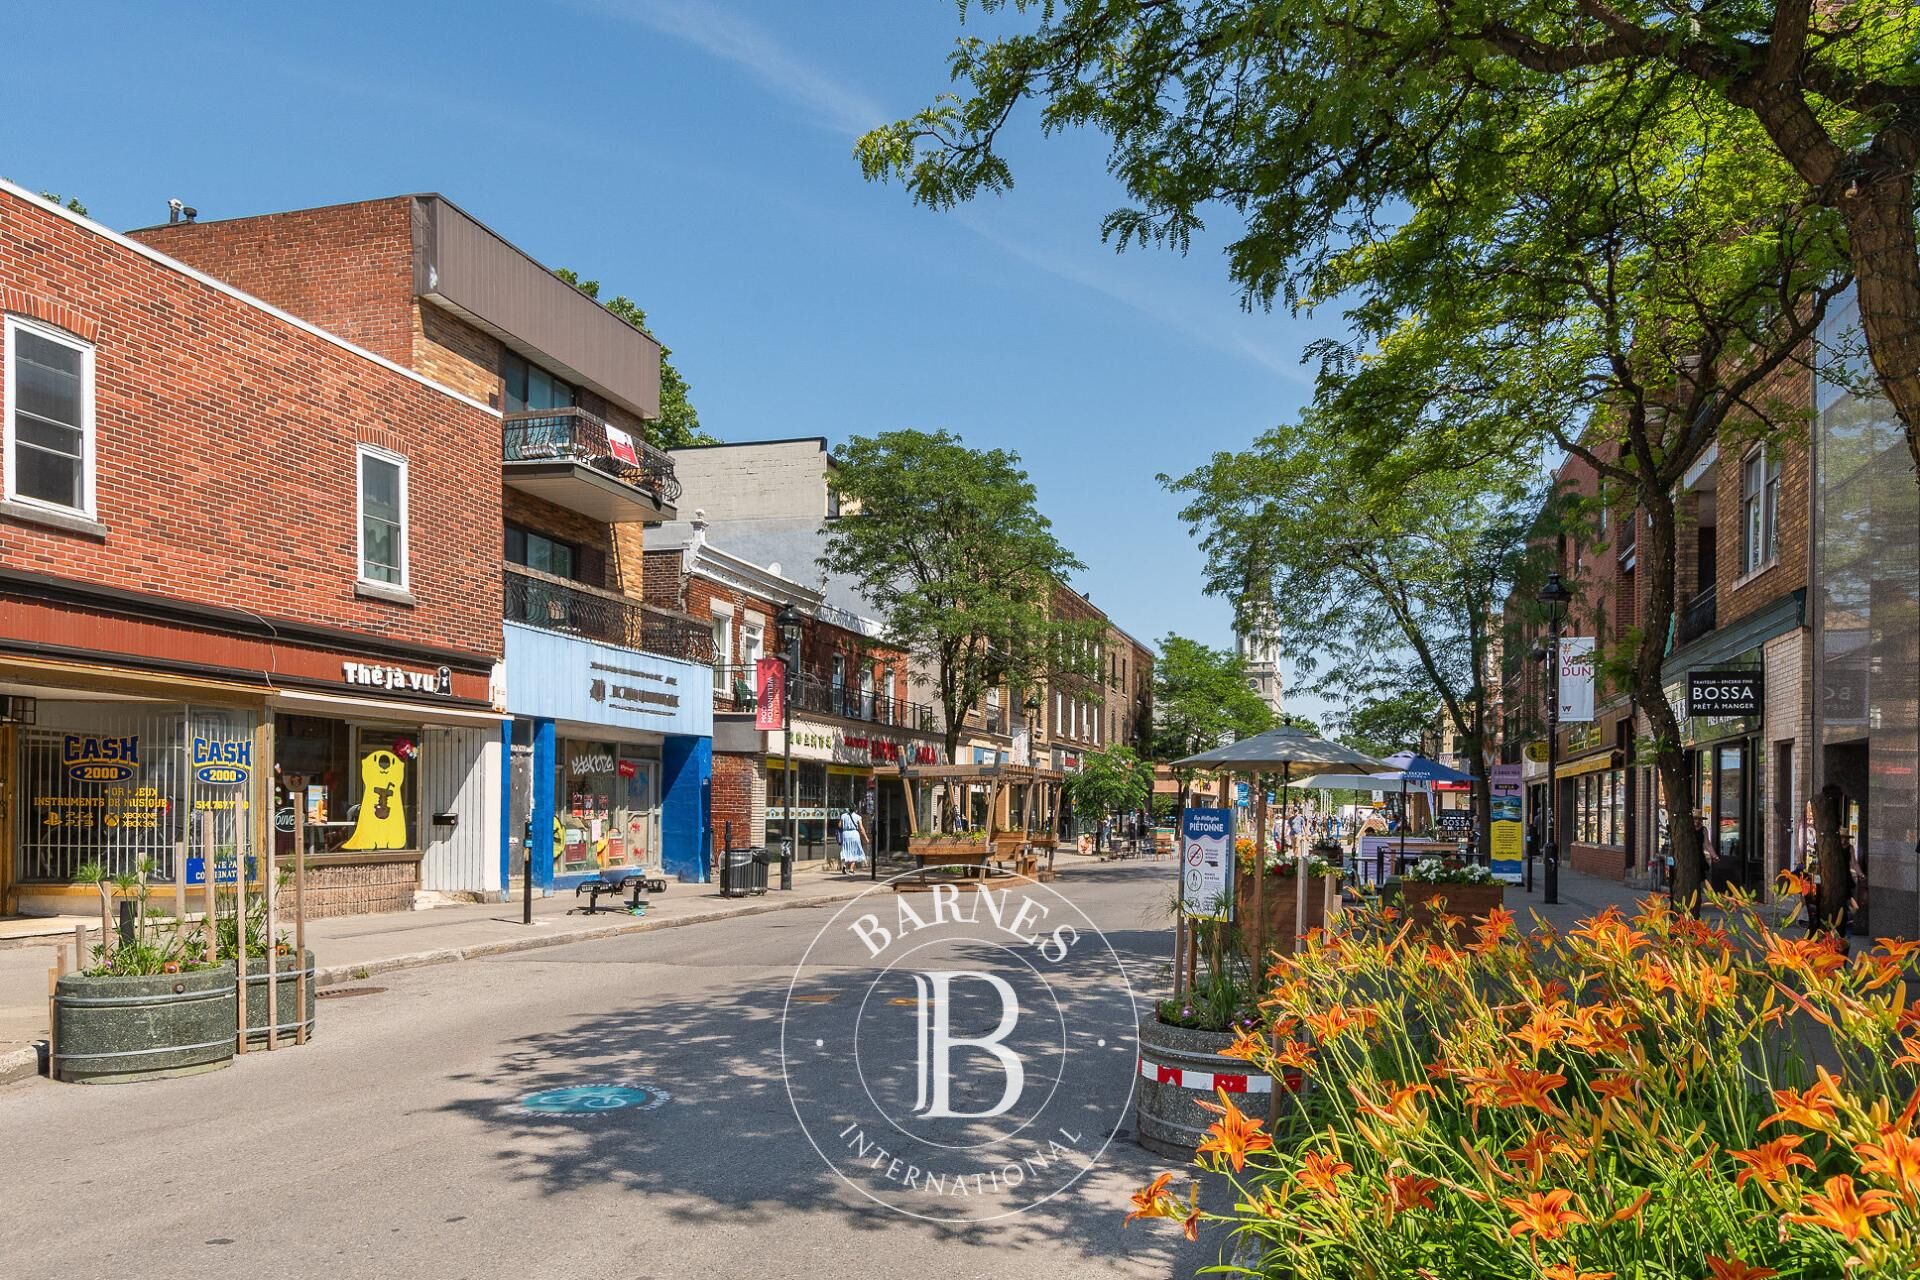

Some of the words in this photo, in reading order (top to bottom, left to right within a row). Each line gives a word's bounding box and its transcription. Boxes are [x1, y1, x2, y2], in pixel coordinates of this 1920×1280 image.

[1561, 667, 1592, 677] DUN
[1692, 686, 1754, 700] BOSSA
[1693, 702, 1711, 710] PRÊT
[1713, 702, 1720, 710] À
[83, 767, 119, 779] 2000
[209, 769, 237, 782] 2000
[111, 788, 125, 796] OR
[135, 788, 159, 797] JEUX
[33, 797, 105, 807] INSTRUMENTS
[124, 798, 168, 809] MUSIQUE
[1189, 821, 1224, 832] PIÉTONNE
[1442, 819, 1471, 827] BOSSA
